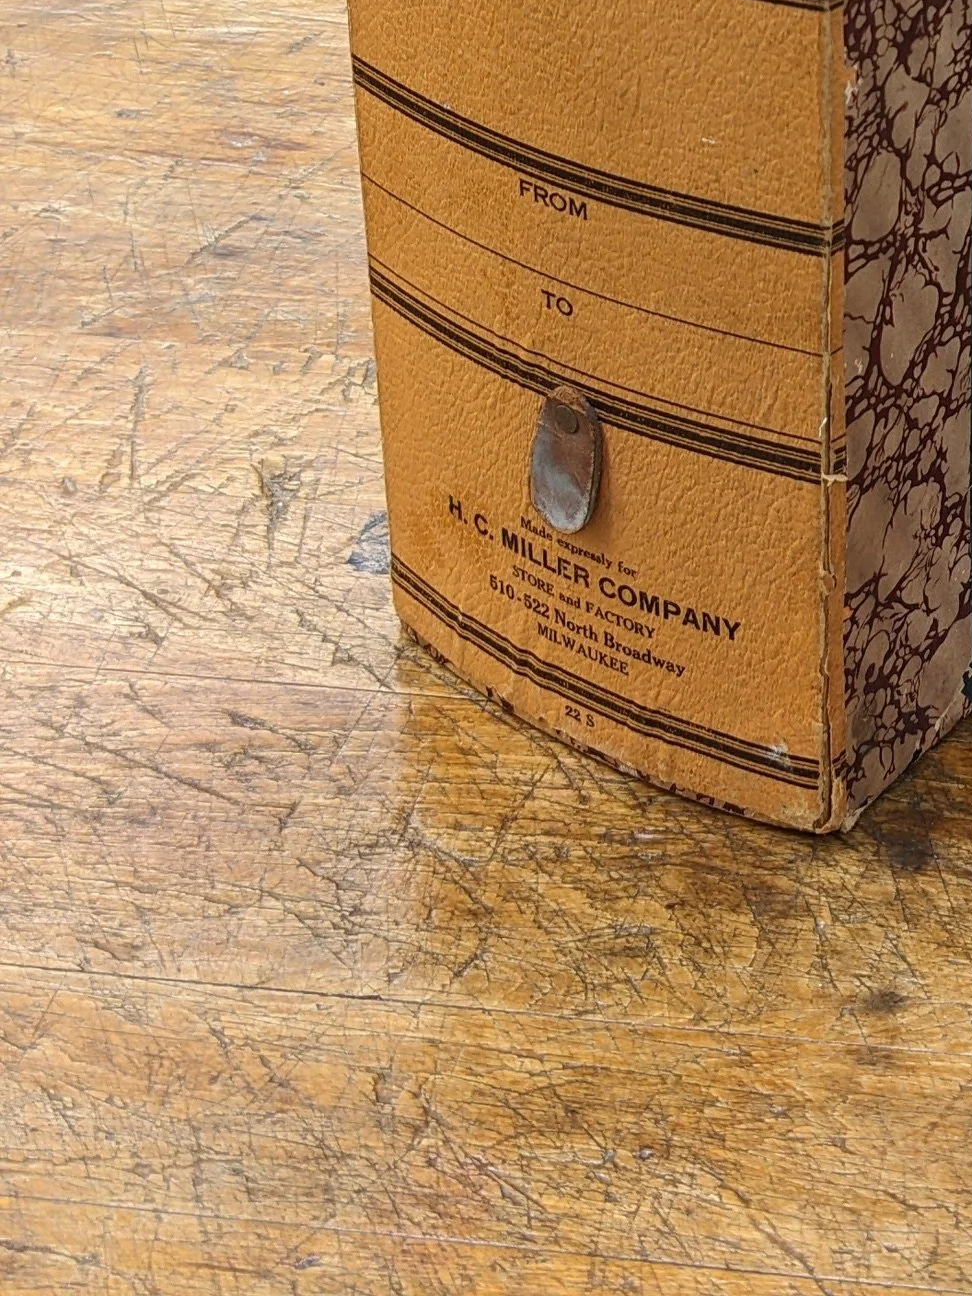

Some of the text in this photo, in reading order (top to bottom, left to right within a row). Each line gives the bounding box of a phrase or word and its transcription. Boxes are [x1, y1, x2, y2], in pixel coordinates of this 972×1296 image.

[518, 178, 588, 221] FROM
[541, 289, 574, 317] TO
[449, 494, 742, 641] H. C. MILLER COMPANY
[520, 515, 638, 579] Made expressly for
[489, 574, 686, 678] 510-522 North Broadway
[512, 565, 656, 639] STORE and FACTORY
[537, 621, 630, 676] MILWAUKEE
[564, 704, 582, 723] 22
